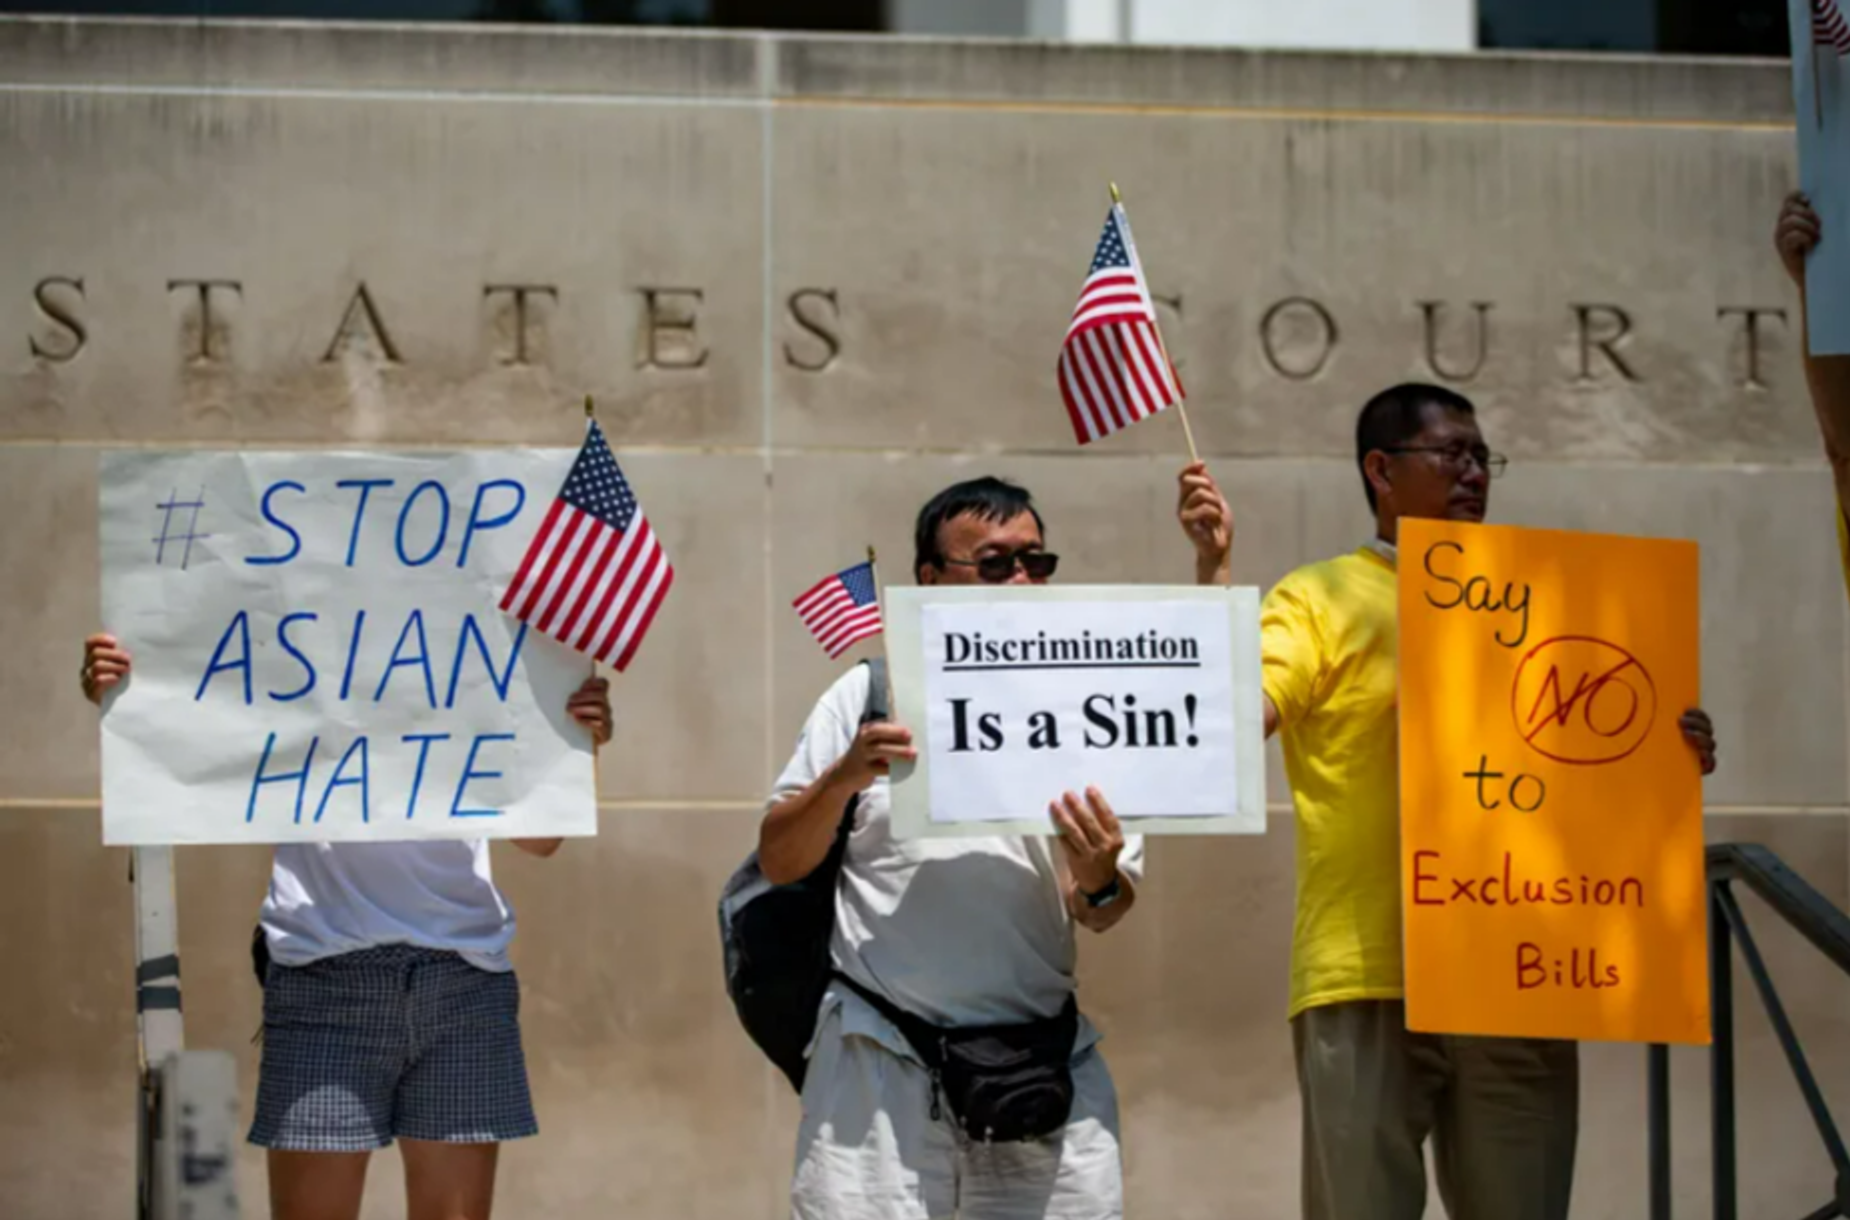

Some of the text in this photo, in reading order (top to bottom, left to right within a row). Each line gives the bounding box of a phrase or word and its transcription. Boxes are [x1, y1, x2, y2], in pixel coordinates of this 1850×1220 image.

[27, 275, 1789, 390] STATES OURT
[244, 479, 527, 568] STOP
[1423, 541, 1531, 648] Say
[194, 608, 528, 708] ASIAN
[942, 629, 1200, 664] Discrimination
[945, 692, 1200, 752] Is a Sin!
[1526, 663, 1639, 738] NO
[245, 732, 516, 824] HATE
[1462, 754, 1546, 812] to
[1413, 850, 1644, 907] Exclusion
[1516, 942, 1621, 990] Bills
